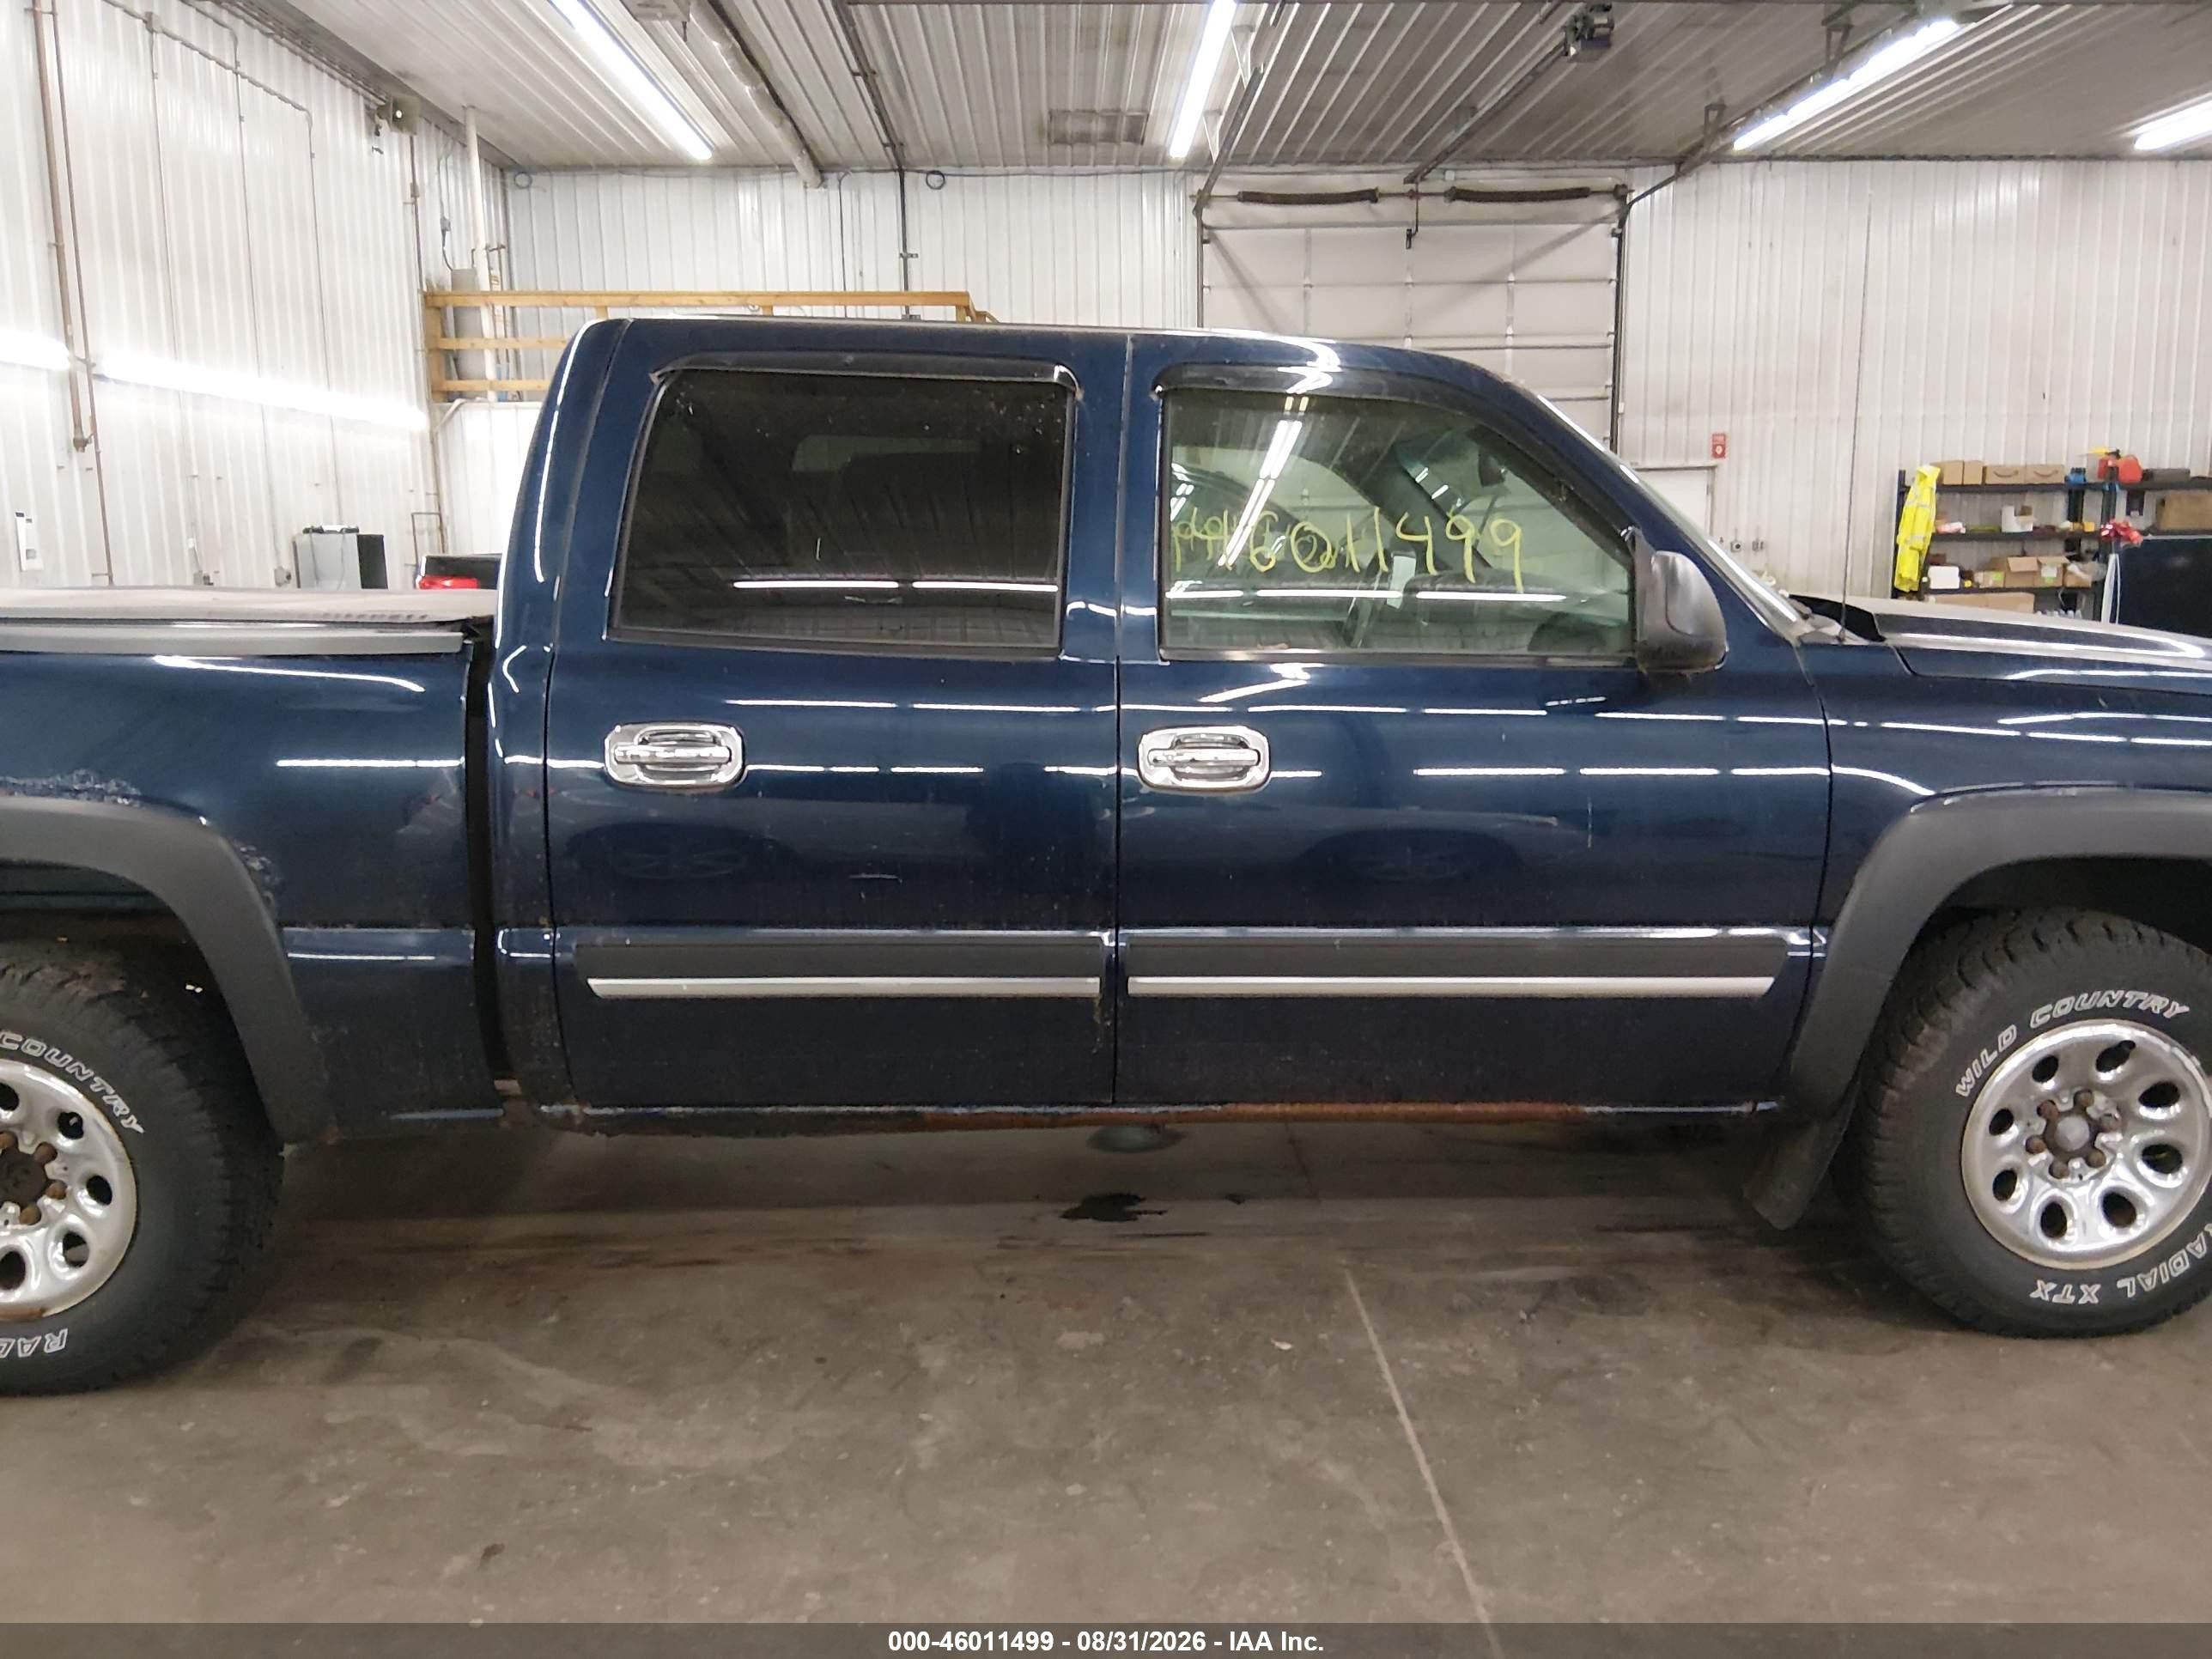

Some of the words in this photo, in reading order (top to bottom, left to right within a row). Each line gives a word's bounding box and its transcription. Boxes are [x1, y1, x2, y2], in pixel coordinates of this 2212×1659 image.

[1955, 1024, 2018, 1097] WILD
[2030, 989, 2190, 1029] COUNTRY
[2029, 1279, 2102, 1305] XTX
[2117, 1223, 2212, 1298] ADIAL
